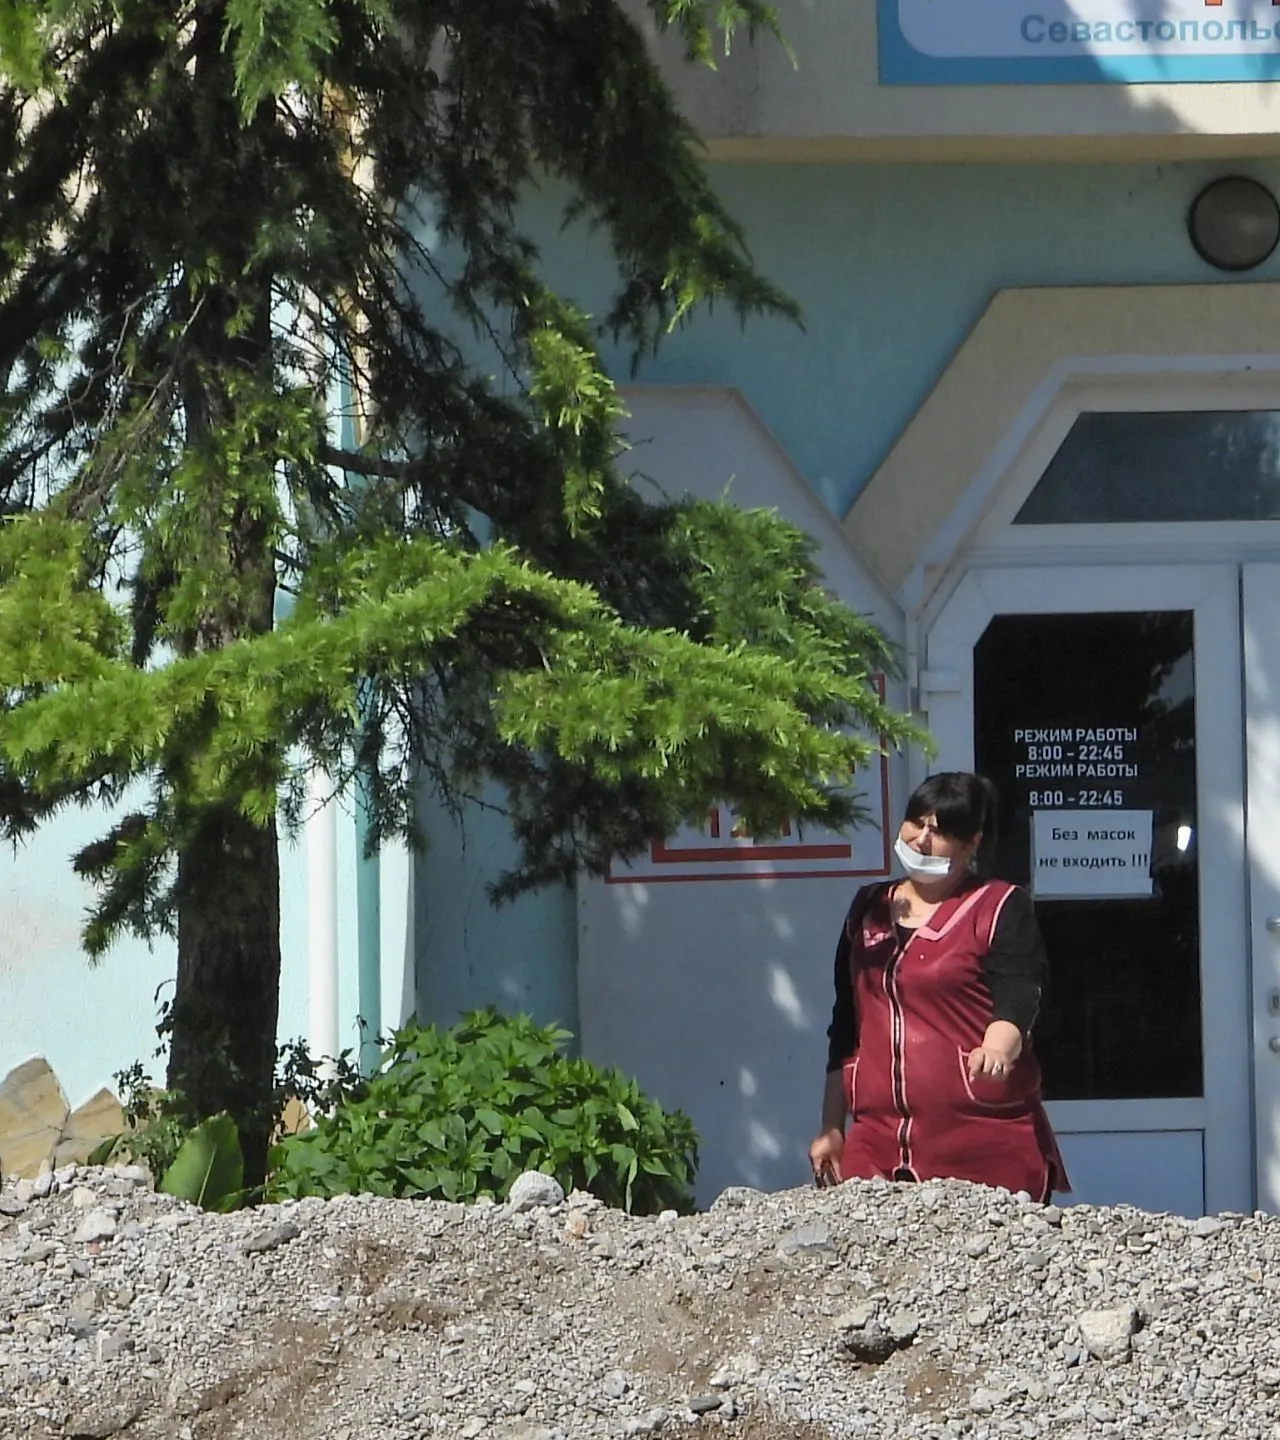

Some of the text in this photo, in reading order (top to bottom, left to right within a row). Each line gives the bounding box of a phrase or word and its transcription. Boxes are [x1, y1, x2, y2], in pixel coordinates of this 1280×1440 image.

[1014, 728, 1137, 743] РЕЖИМ РАБОТЫ
[1028, 746, 1062, 760] 8:00
[1079, 745, 1123, 760] 22:45
[1016, 764, 1138, 778] РЕЖИМ РАБОТЫ
[1029, 791, 1063, 806] 8:00
[1079, 790, 1123, 805] 22:45
[1052, 827, 1135, 841] Без масок
[1039, 854, 1148, 868] не входить !!!
